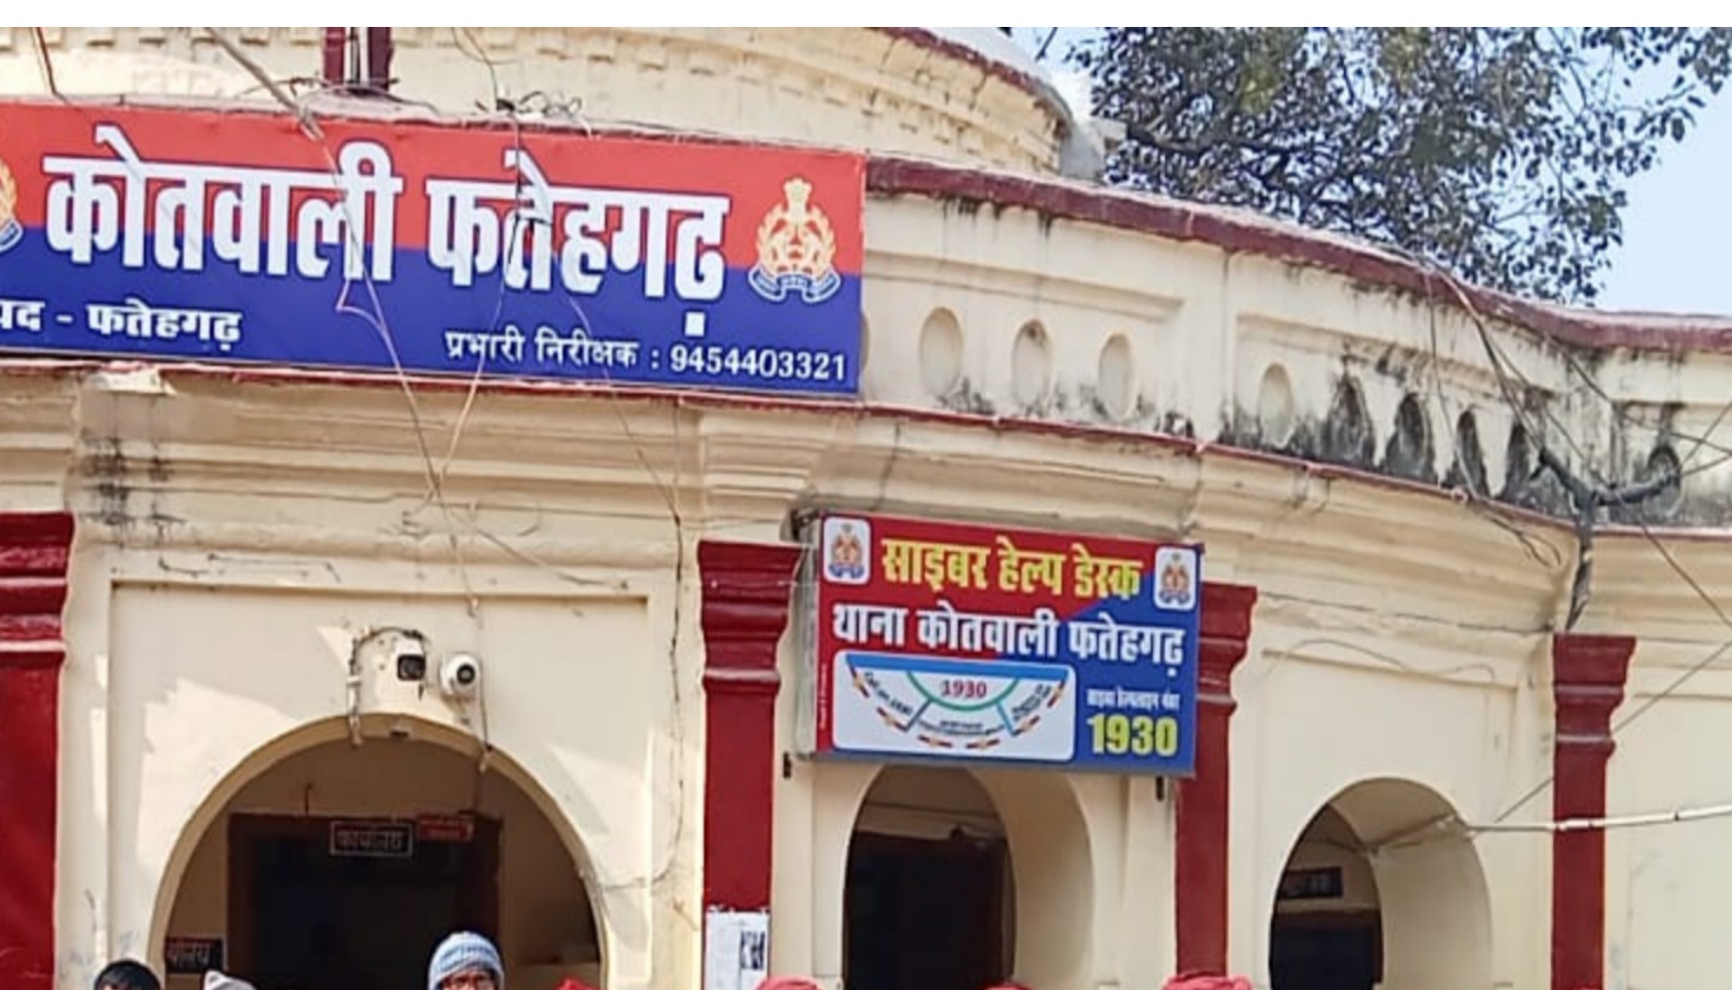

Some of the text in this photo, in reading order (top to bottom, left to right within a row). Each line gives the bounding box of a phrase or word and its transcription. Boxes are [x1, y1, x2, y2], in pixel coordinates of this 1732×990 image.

[43, 126, 730, 335] कोतवाली फतेहगढ़
[86, 297, 243, 351] फतेहगढ़
[445, 325, 525, 362] प्रभारी
[533, 326, 640, 368] निरीक्षक
[670, 344, 845, 381] 9454403321
[881, 535, 1145, 600] साइबर हेल्प डेस्क
[833, 600, 1186, 678] थाना कोतवाली फतेहगढ़
[941, 679, 987, 699] 1930
[1086, 713, 1179, 758] 1930
